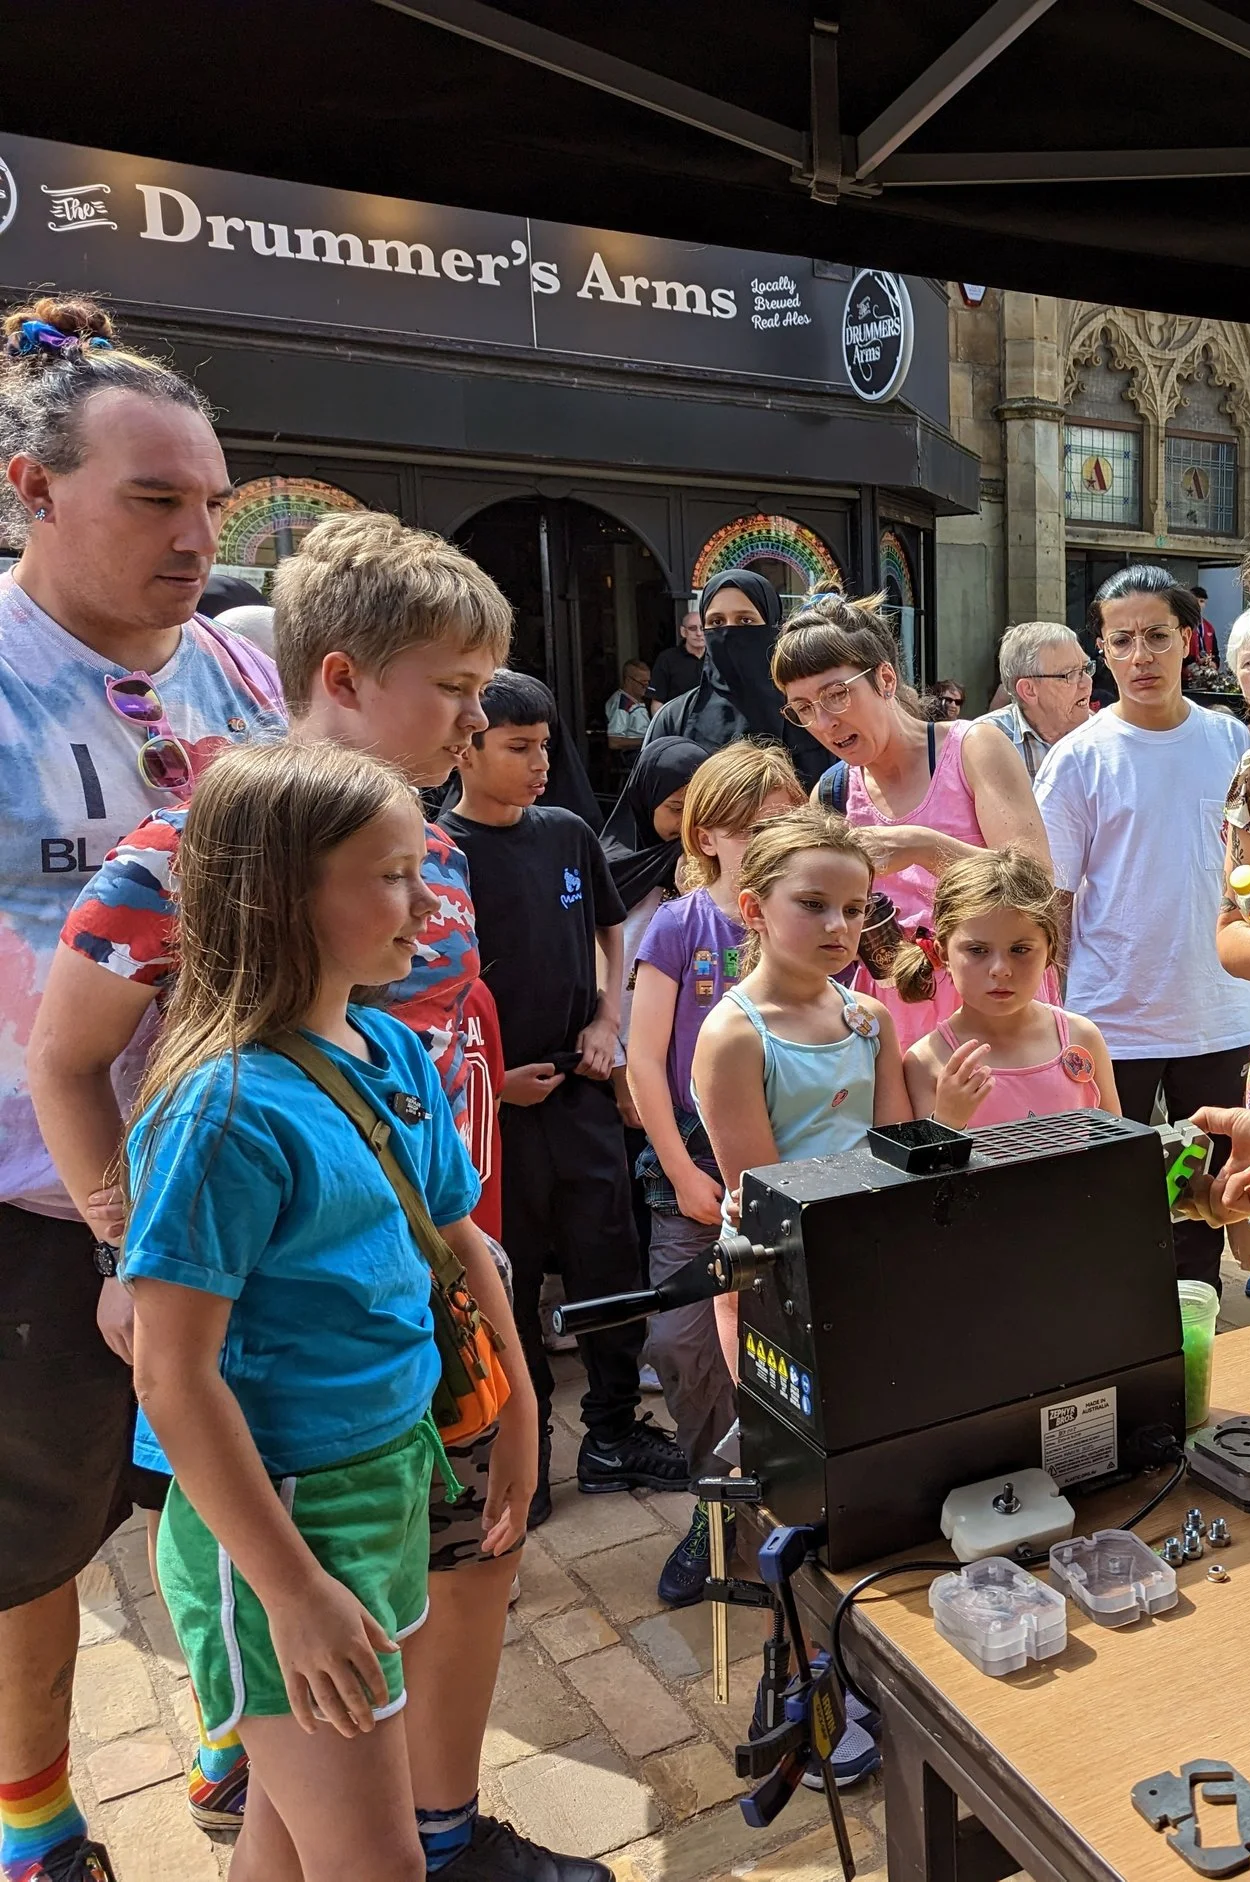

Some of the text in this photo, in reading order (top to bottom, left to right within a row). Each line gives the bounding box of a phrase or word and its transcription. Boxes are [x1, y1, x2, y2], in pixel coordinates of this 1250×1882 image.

[61, 183, 738, 319] The Drummer's Arms
[751, 276, 796, 295] Locally
[754, 293, 801, 311] Brewed
[752, 312, 812, 330] Real Ales
[846, 317, 901, 346] DRUMMERS
[853, 345, 881, 365] Arms
[70, 743, 106, 819] I
[41, 836, 126, 873] BL
[1049, 1406, 1076, 1420] ZEPHYR
[1082, 1402, 1110, 1415] AUSTRALIA
[1085, 1399, 1100, 1408] MADE
